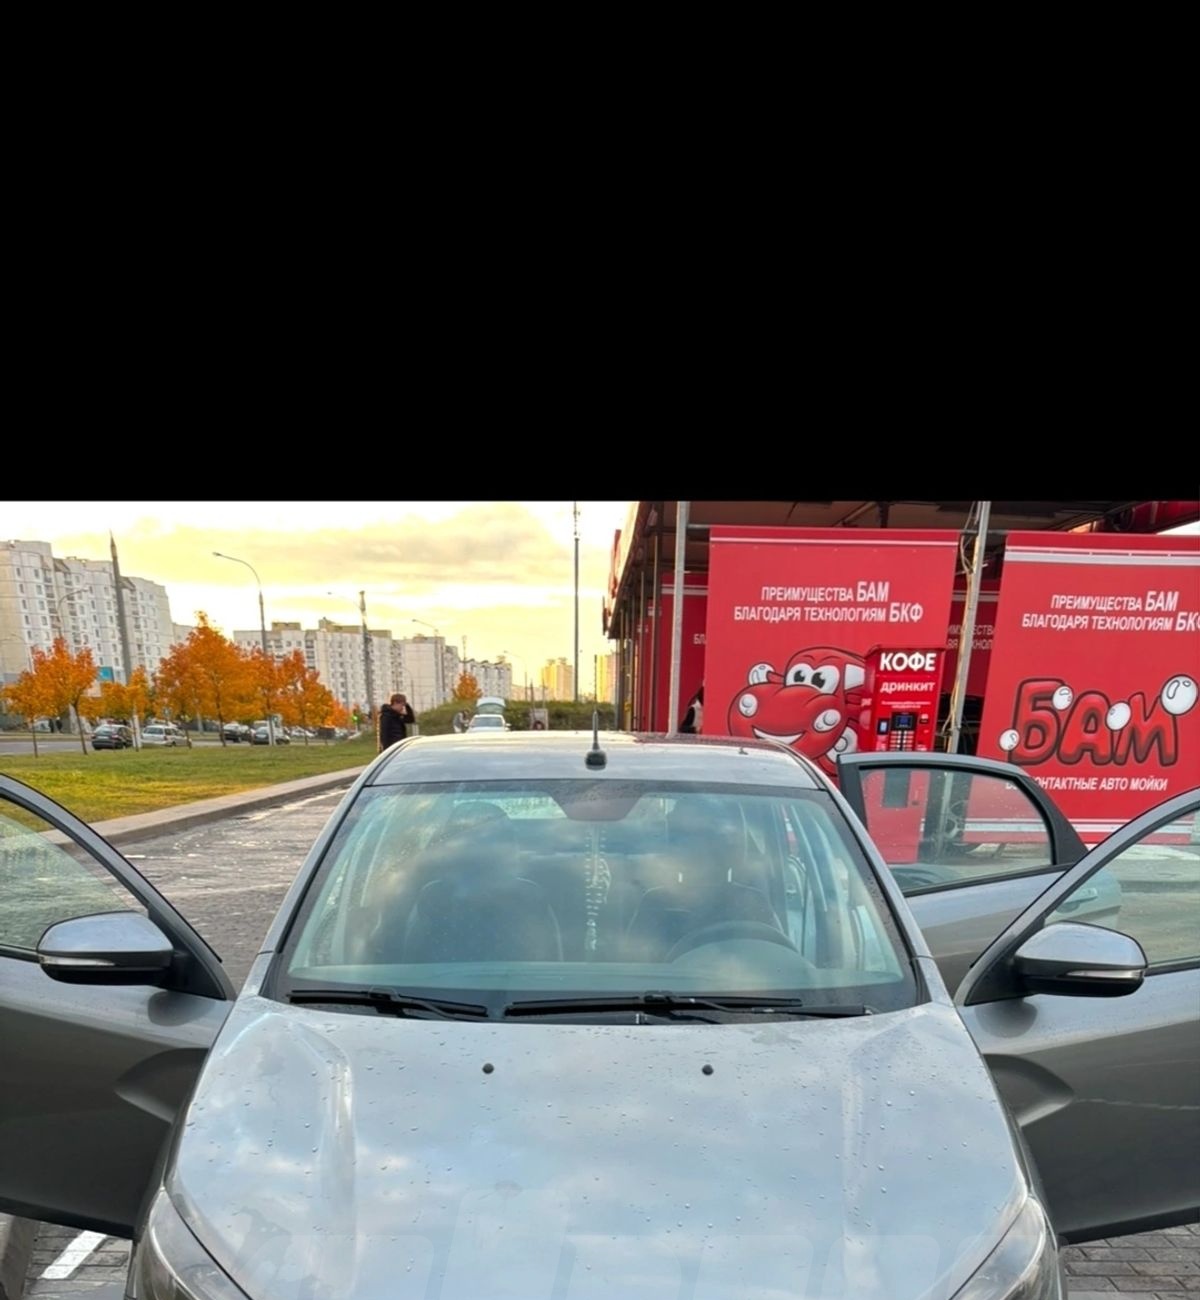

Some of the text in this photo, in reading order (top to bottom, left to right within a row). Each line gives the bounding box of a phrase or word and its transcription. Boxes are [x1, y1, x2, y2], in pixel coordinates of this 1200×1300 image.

[761, 581, 890, 602] ПРЕИМУЩЕСТВА БАМ
[1051, 591, 1179, 612] ПРЕИМУЩЕСТВА БАМ
[734, 602, 923, 622] БЛАГОДАРЯ ТЕХНОЛОГИЯМ БКФ
[1022, 612, 1200, 632] БЛАГОДАРЯ ТЕХНОЛОГИЯМ БК
[880, 652, 937, 671] КОФЕ
[1007, 677, 1178, 767] БАМ
[1099, 777, 1127, 791] АВТО
[1129, 775, 1168, 791] МОЙКИ
